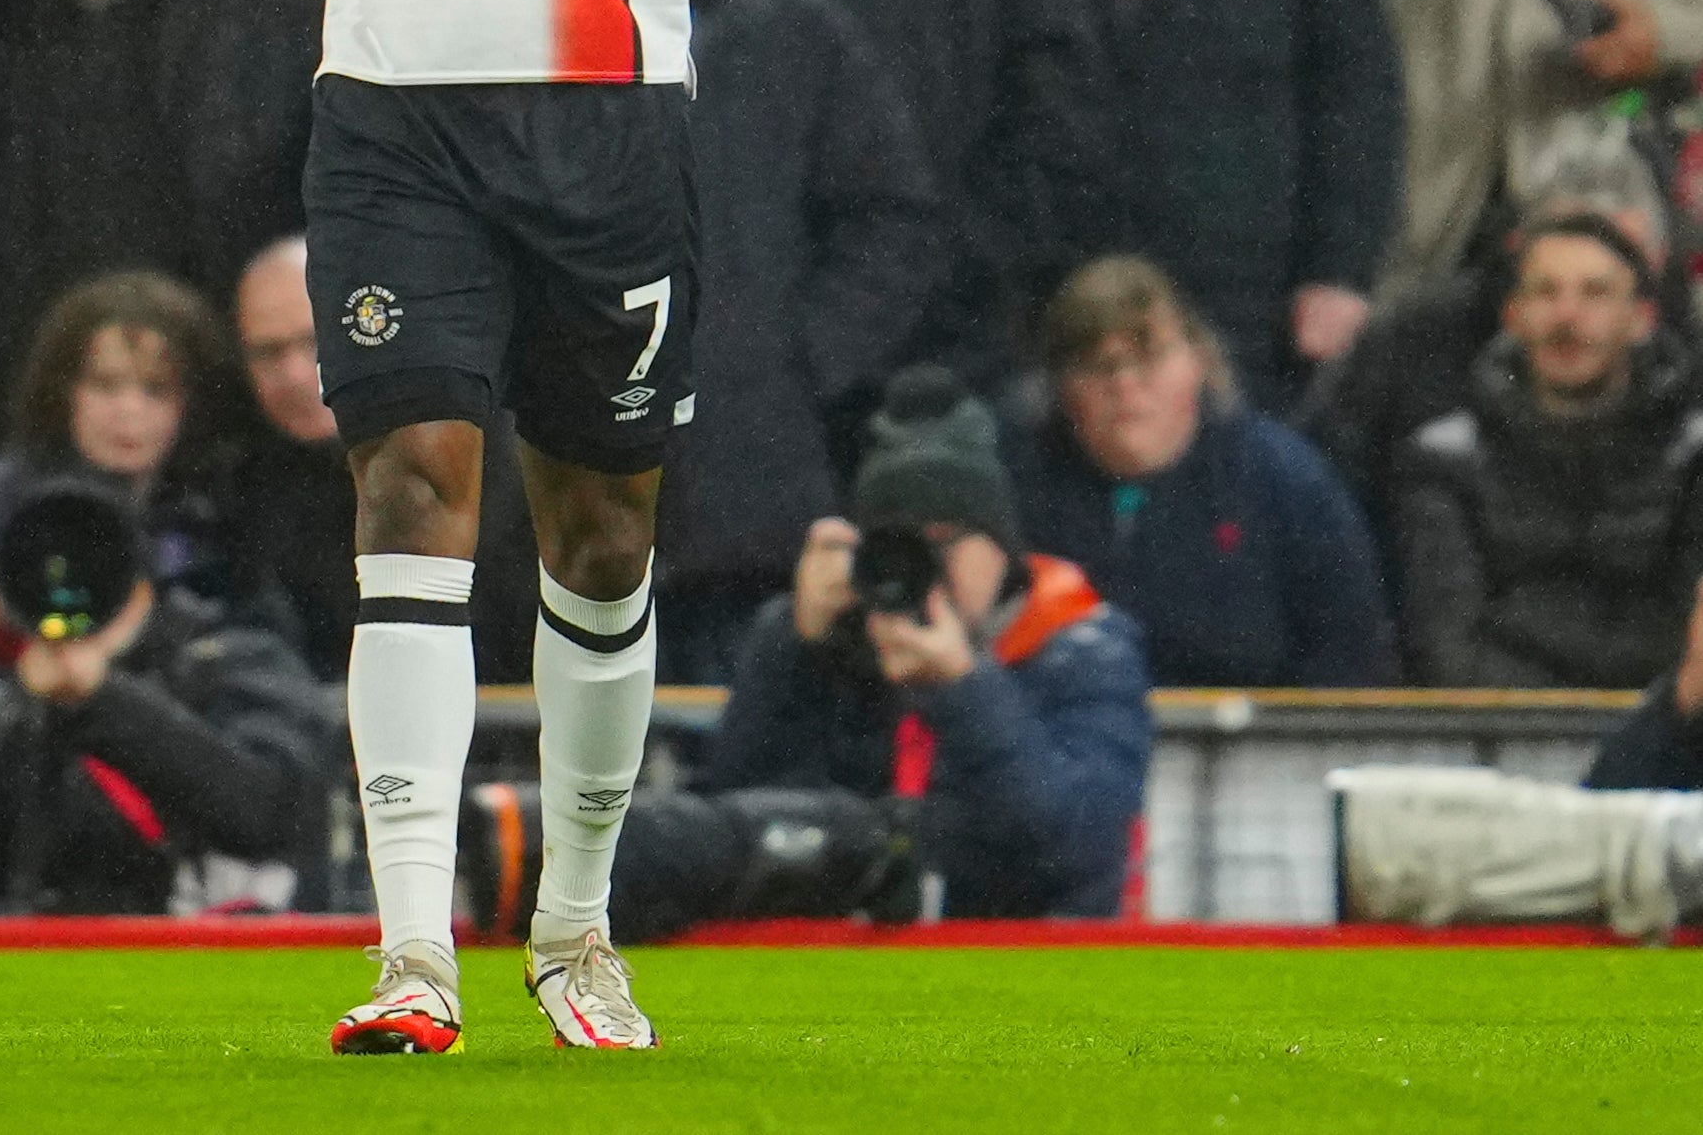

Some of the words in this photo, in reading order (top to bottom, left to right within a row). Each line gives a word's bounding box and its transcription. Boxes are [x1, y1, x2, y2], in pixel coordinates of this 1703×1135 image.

[344, 286, 370, 309] LUTON
[371, 284, 396, 303] TOWN
[623, 275, 671, 381] 7
[615, 407, 650, 422] umbro
[369, 795, 412, 808] umbro
